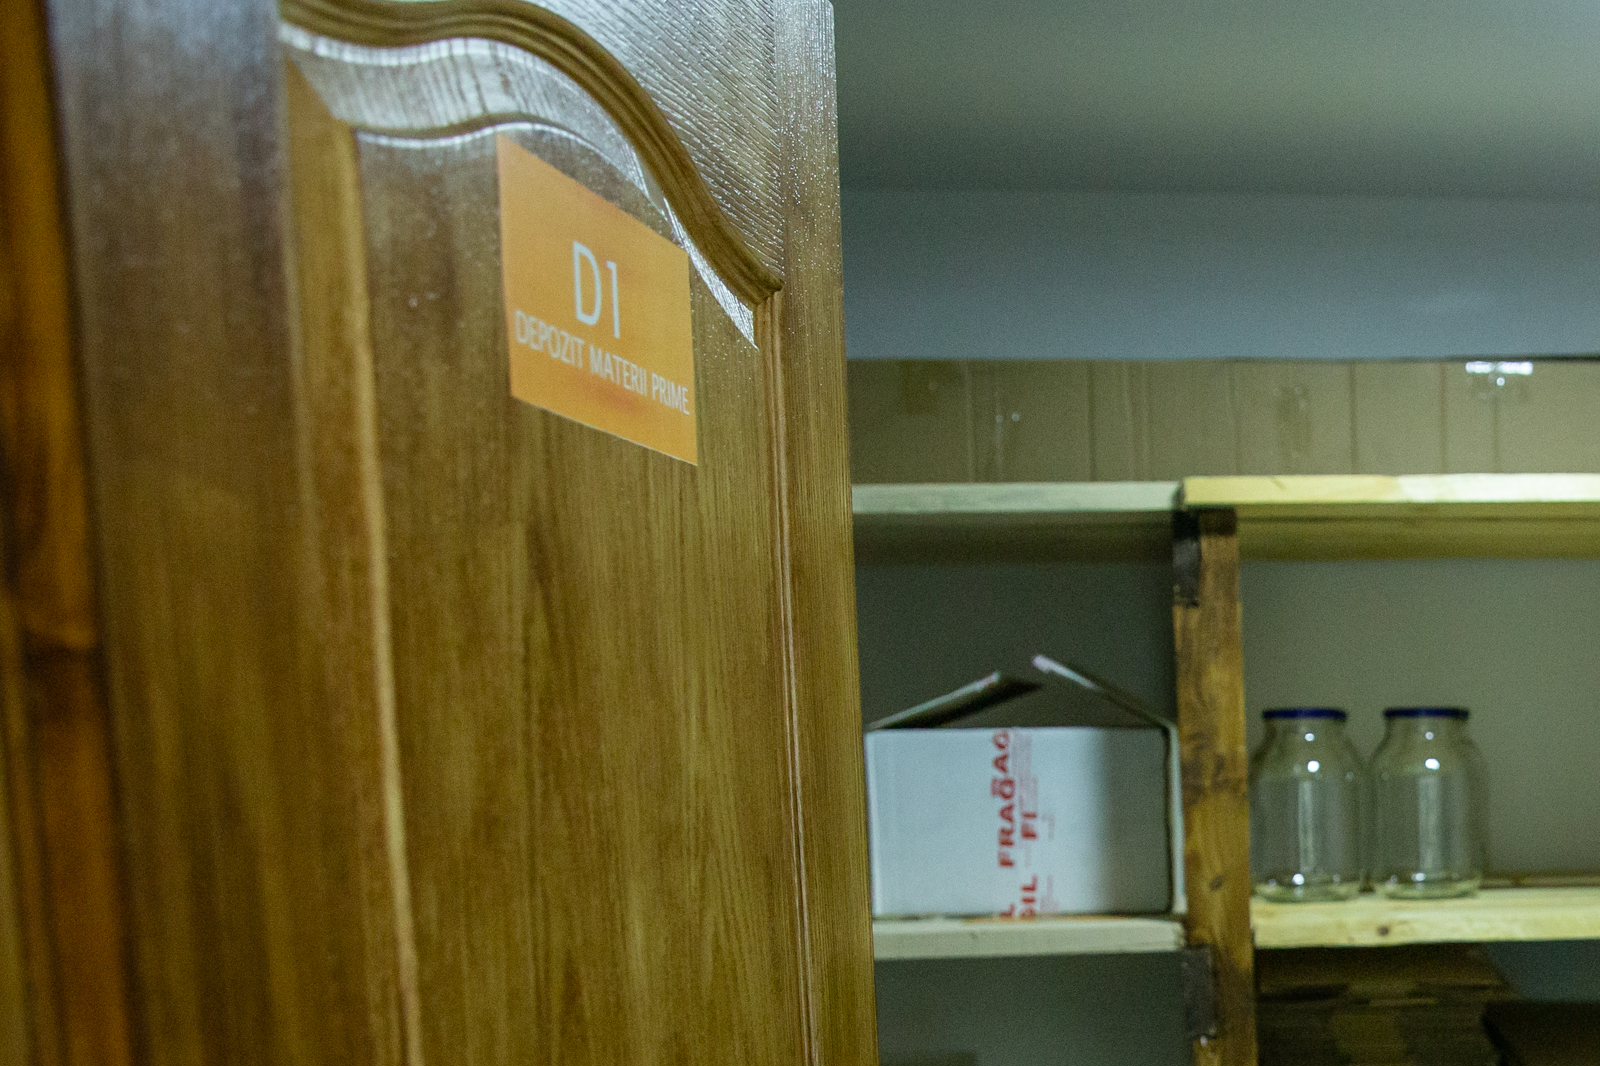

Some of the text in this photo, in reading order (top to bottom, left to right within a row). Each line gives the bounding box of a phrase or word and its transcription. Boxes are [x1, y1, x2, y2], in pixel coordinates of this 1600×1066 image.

[572, 240, 620, 339] D1
[514, 309, 690, 415] DEPOZIT MATERII PRIME
